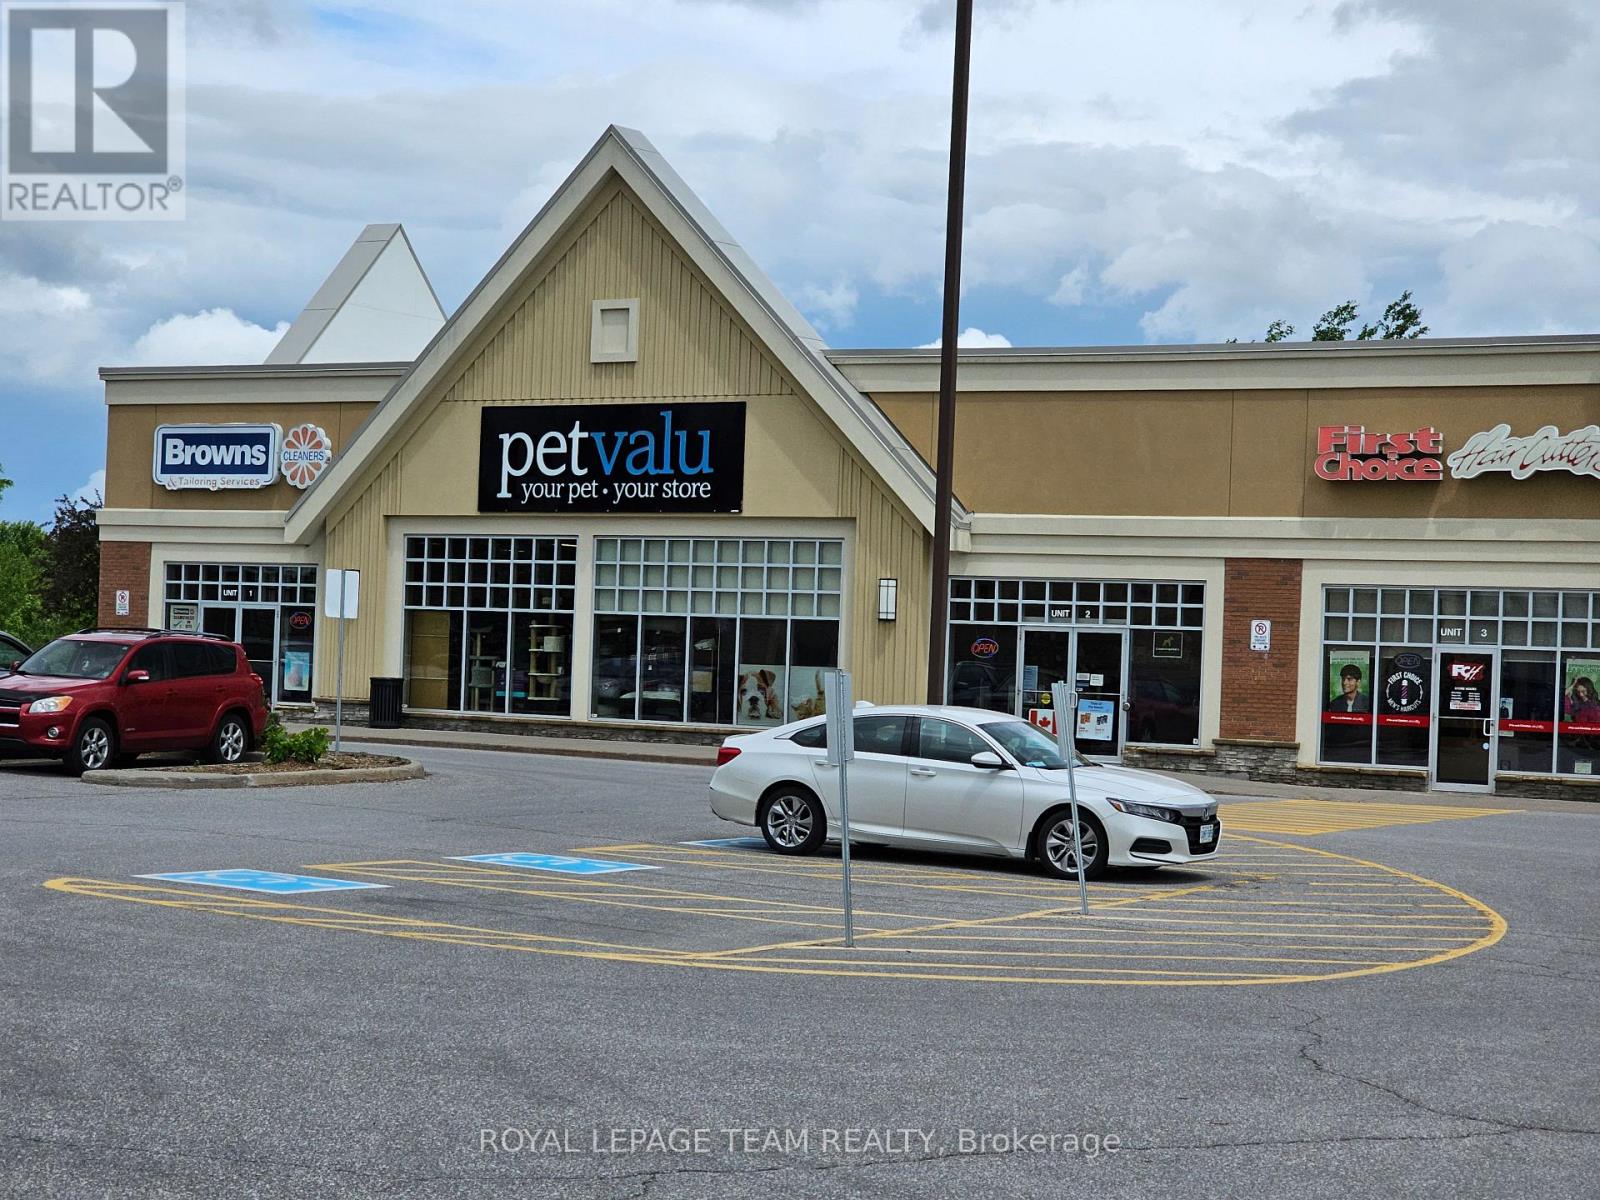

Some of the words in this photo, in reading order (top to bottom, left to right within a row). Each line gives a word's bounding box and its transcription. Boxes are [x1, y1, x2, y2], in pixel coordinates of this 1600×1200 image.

[1318, 425, 1443, 454] First
[165, 438, 267, 466] Browns
[283, 450, 325, 462] CLEANERS
[1455, 440, 1526, 471] Hair
[1314, 452, 1443, 480] Choice
[167, 475, 177, 488] &
[178, 476, 217, 488] Tailoring
[220, 476, 260, 486] Services
[521, 482, 565, 504] your
[568, 480, 599, 504] pet
[613, 482, 659, 504] your
[662, 481, 711, 498] store
[223, 589, 238, 597] UNIT
[290, 614, 310, 626] OPEN
[1051, 609, 1071, 617] UNIT
[1085, 610, 1091, 618] 2
[1440, 627, 1463, 637] UNIT
[1480, 628, 1488, 638] 3
[973, 643, 997, 654] OPEN
[1396, 656, 1421, 665] OPEN
[1387, 671, 1403, 685] FIRST
[1403, 671, 1423, 686] CHOICE
[1387, 698, 1401, 711] MEN'S
[1400, 699, 1422, 712] HAIRCUTS
